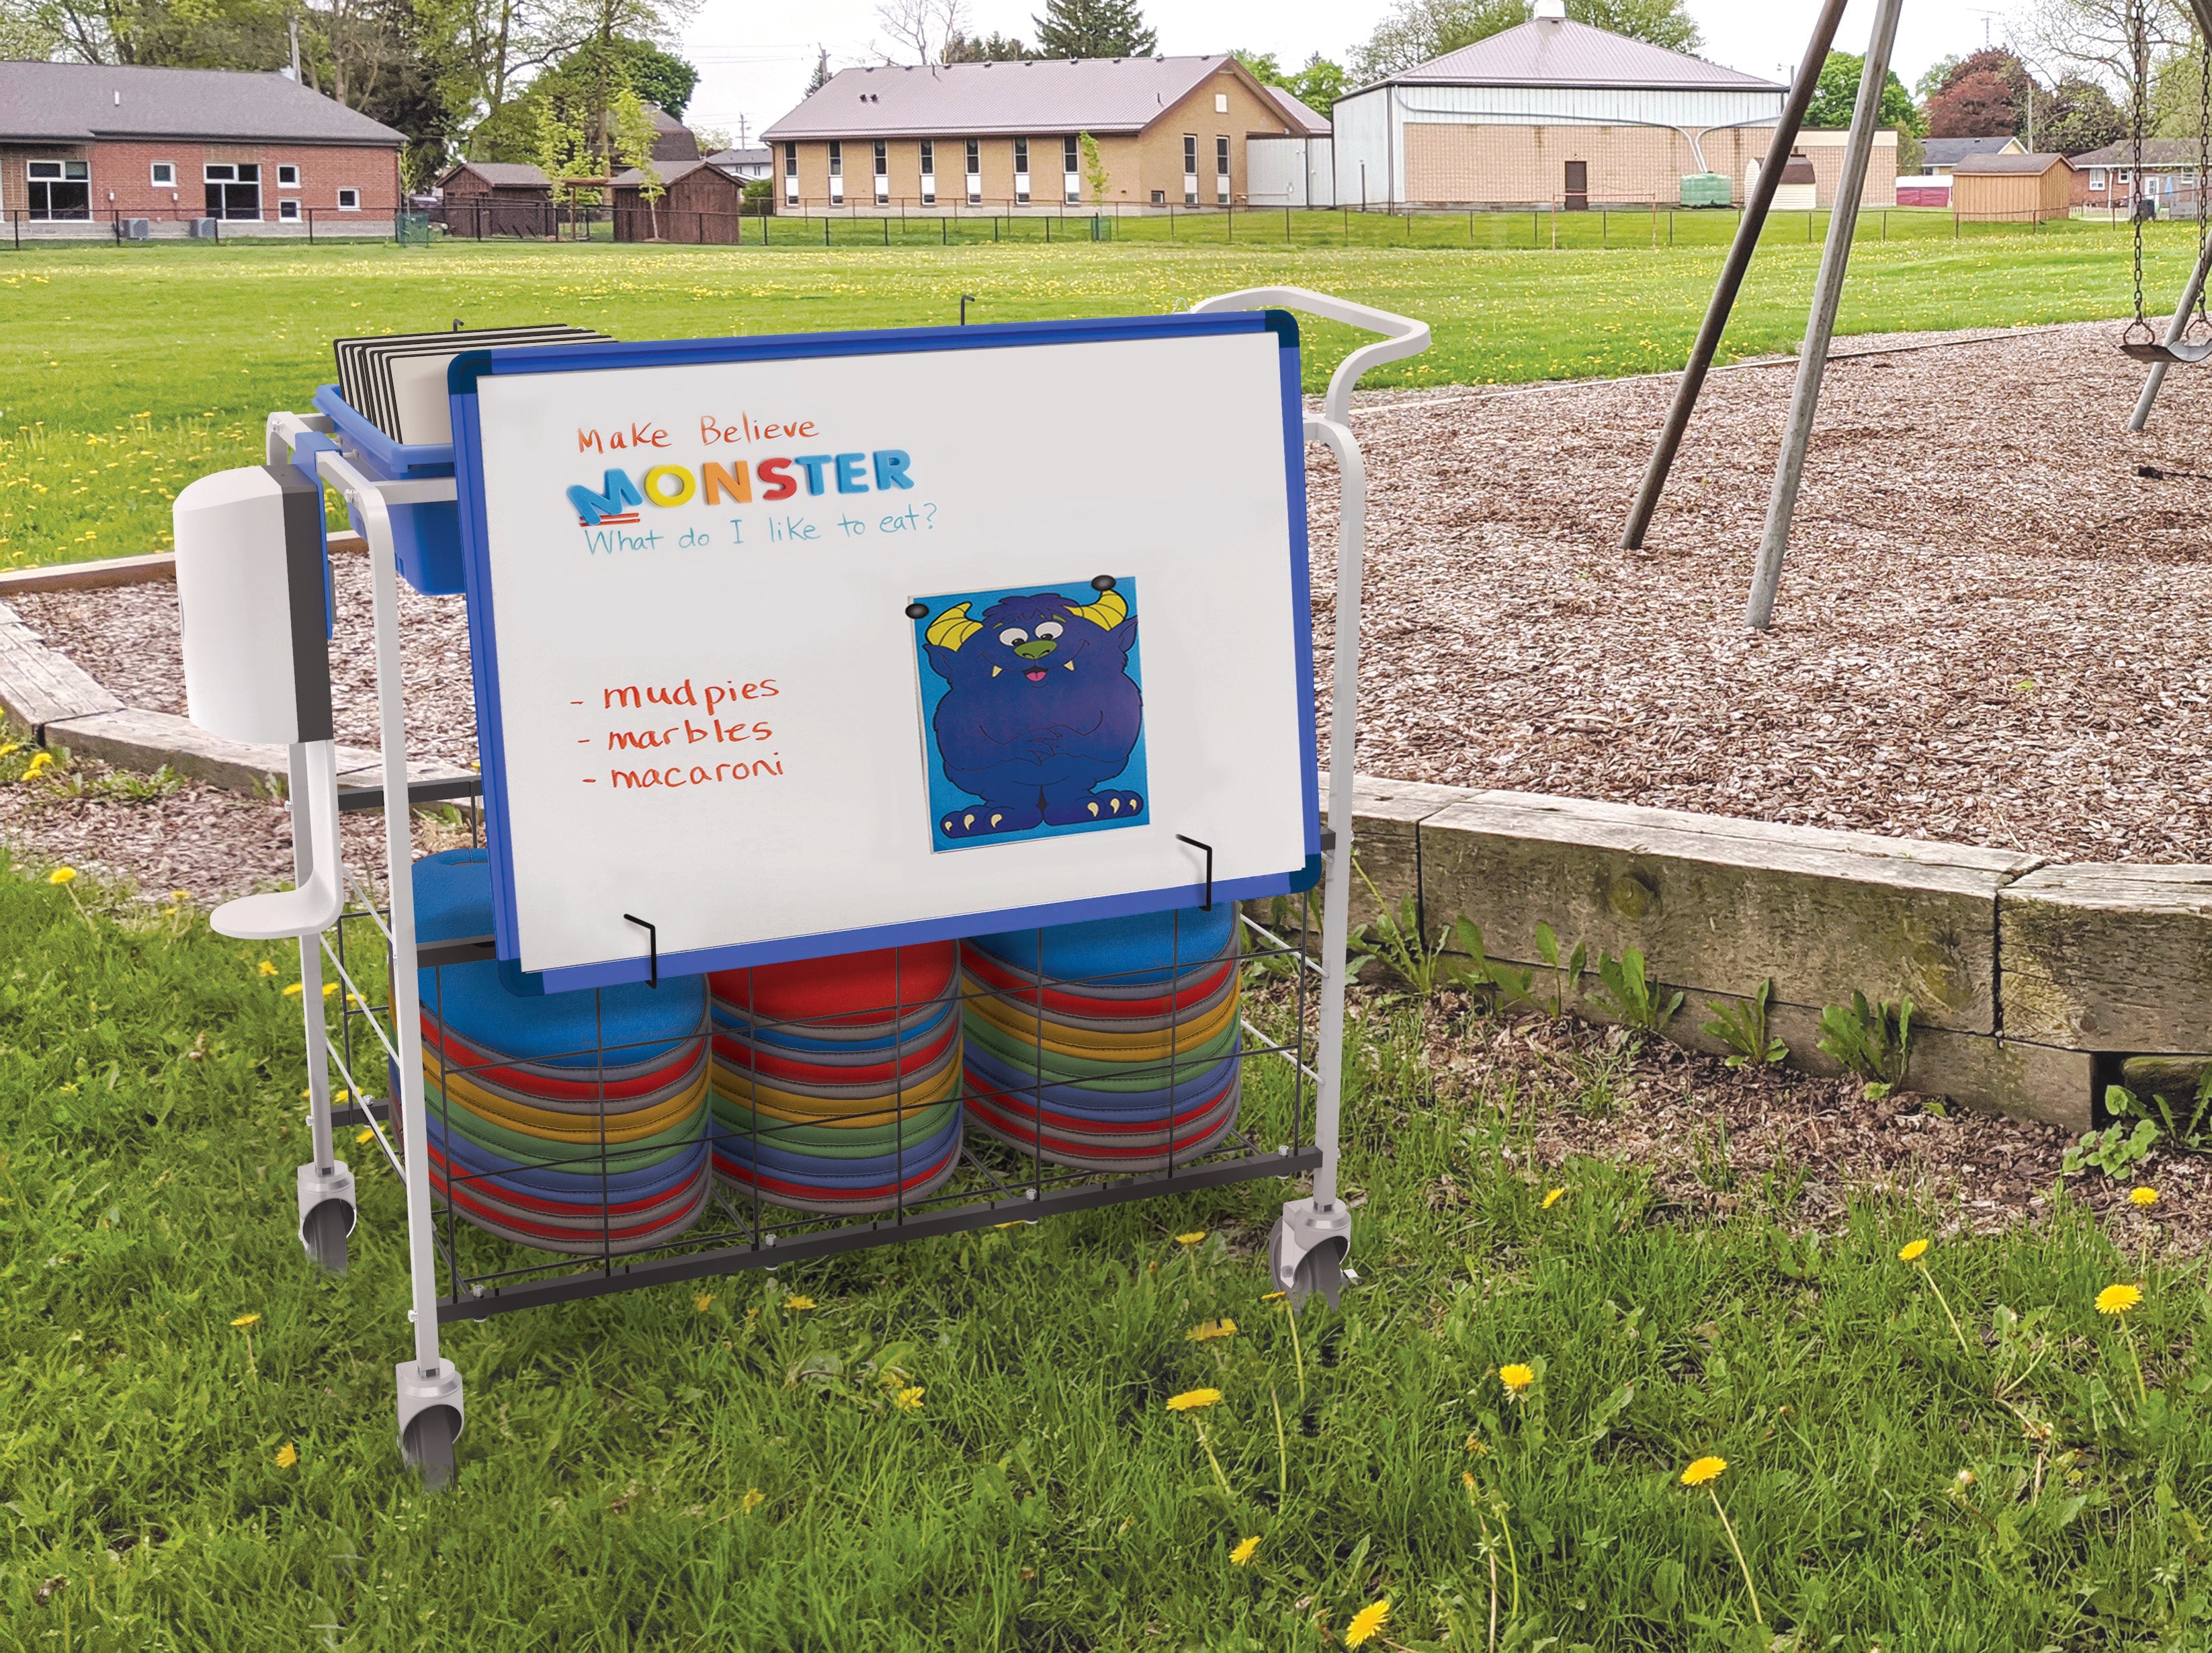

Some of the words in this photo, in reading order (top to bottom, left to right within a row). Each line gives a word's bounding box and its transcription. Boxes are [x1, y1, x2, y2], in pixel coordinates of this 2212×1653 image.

[577, 422, 672, 454] Make
[700, 411, 820, 446] Believe
[566, 450, 914, 526] MONSTER
[585, 528, 664, 555] What
[679, 527, 710, 548] do
[730, 519, 744, 544] I
[769, 517, 820, 541] like
[837, 513, 865, 537] to
[879, 503, 937, 533] eat?
[608, 719, 773, 751] marbles
[611, 751, 784, 789] macaroni
